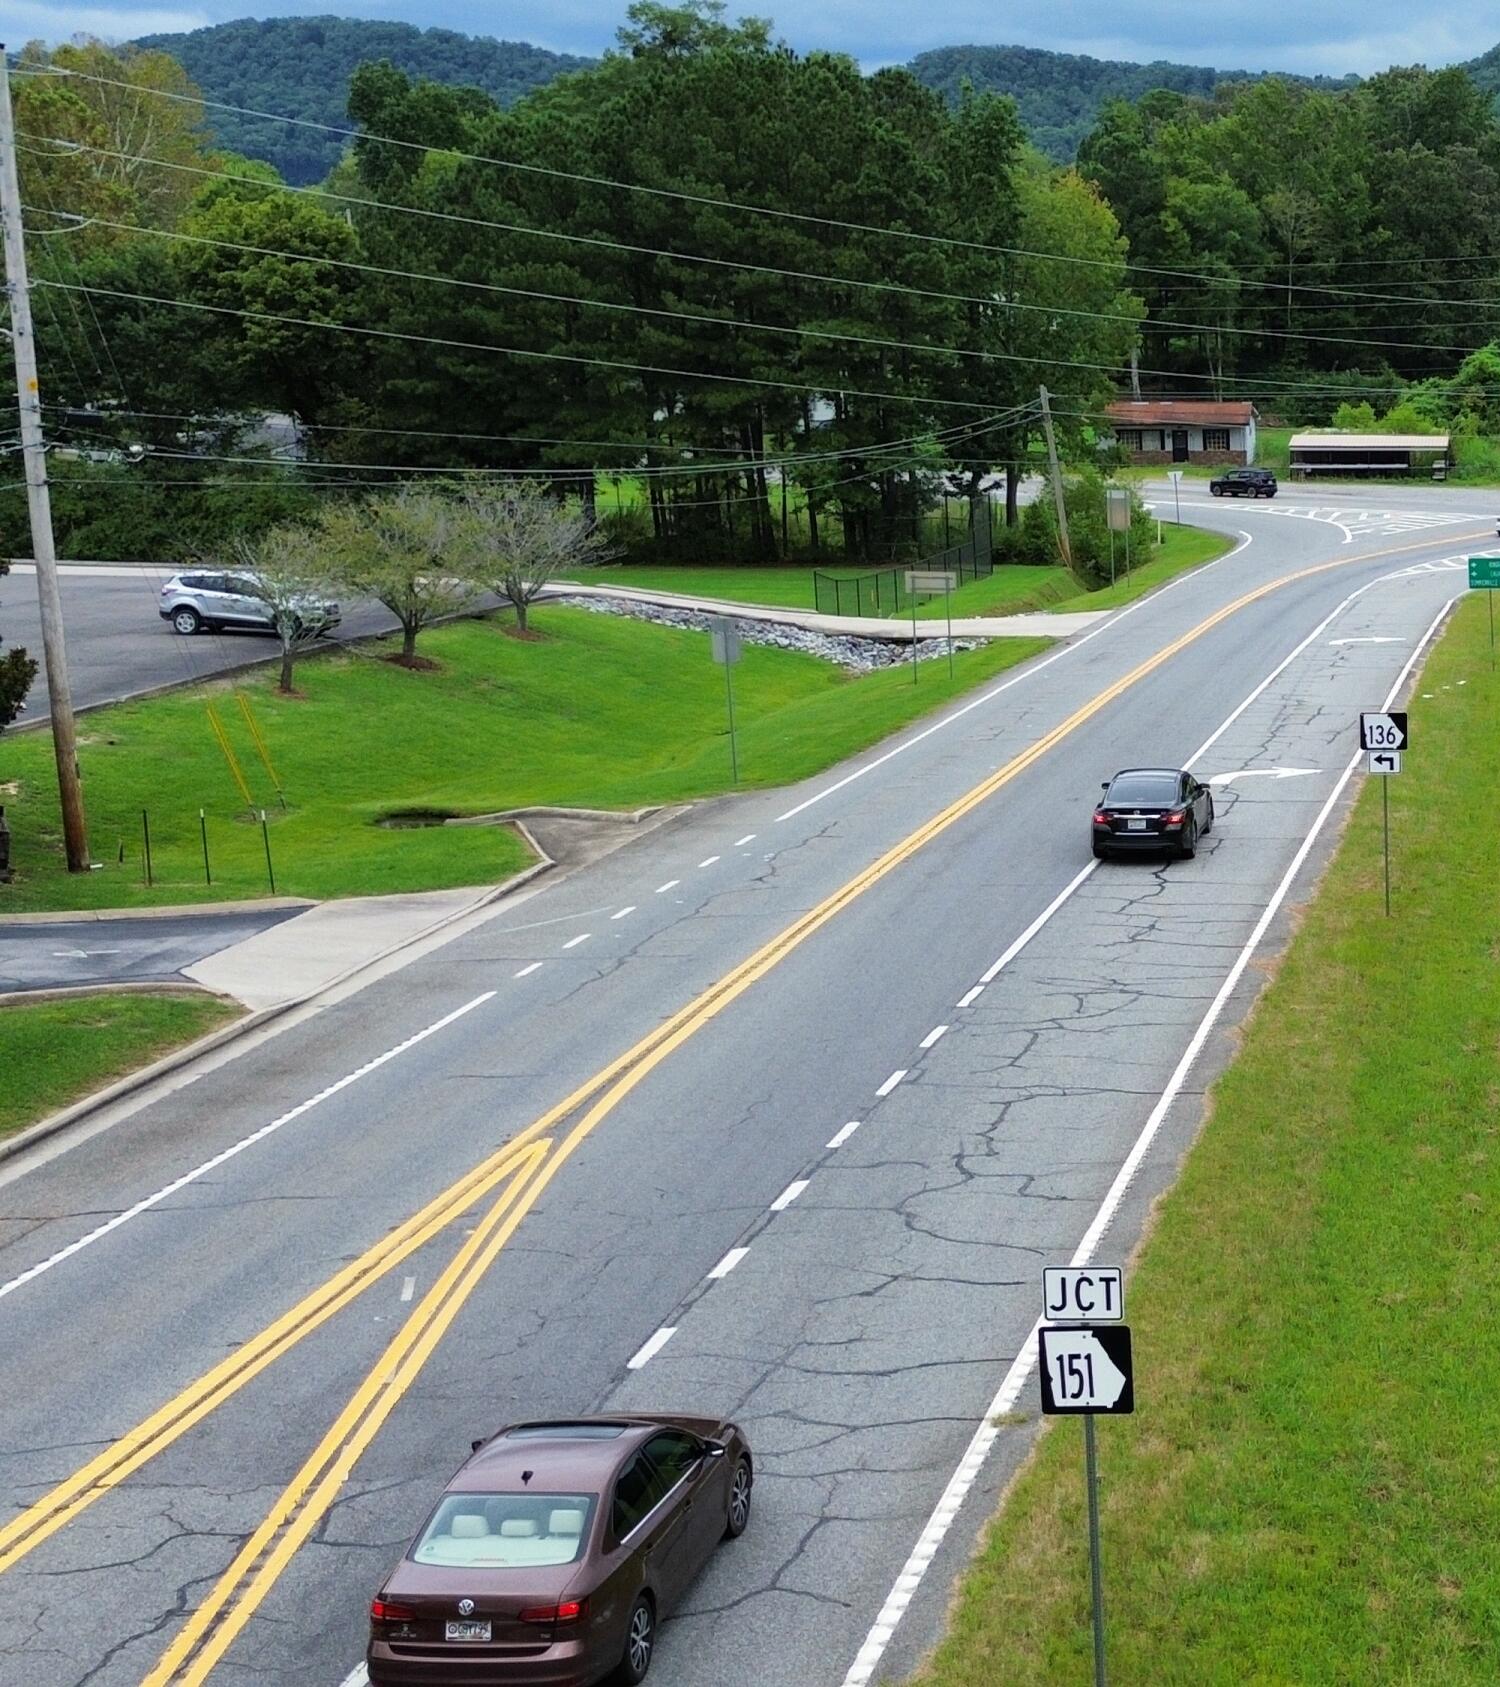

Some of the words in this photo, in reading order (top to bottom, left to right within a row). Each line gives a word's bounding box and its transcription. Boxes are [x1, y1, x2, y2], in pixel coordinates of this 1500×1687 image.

[1369, 725, 1396, 745] 136
[1050, 1277, 1117, 1312] JCT
[1056, 1353, 1095, 1399] 151
